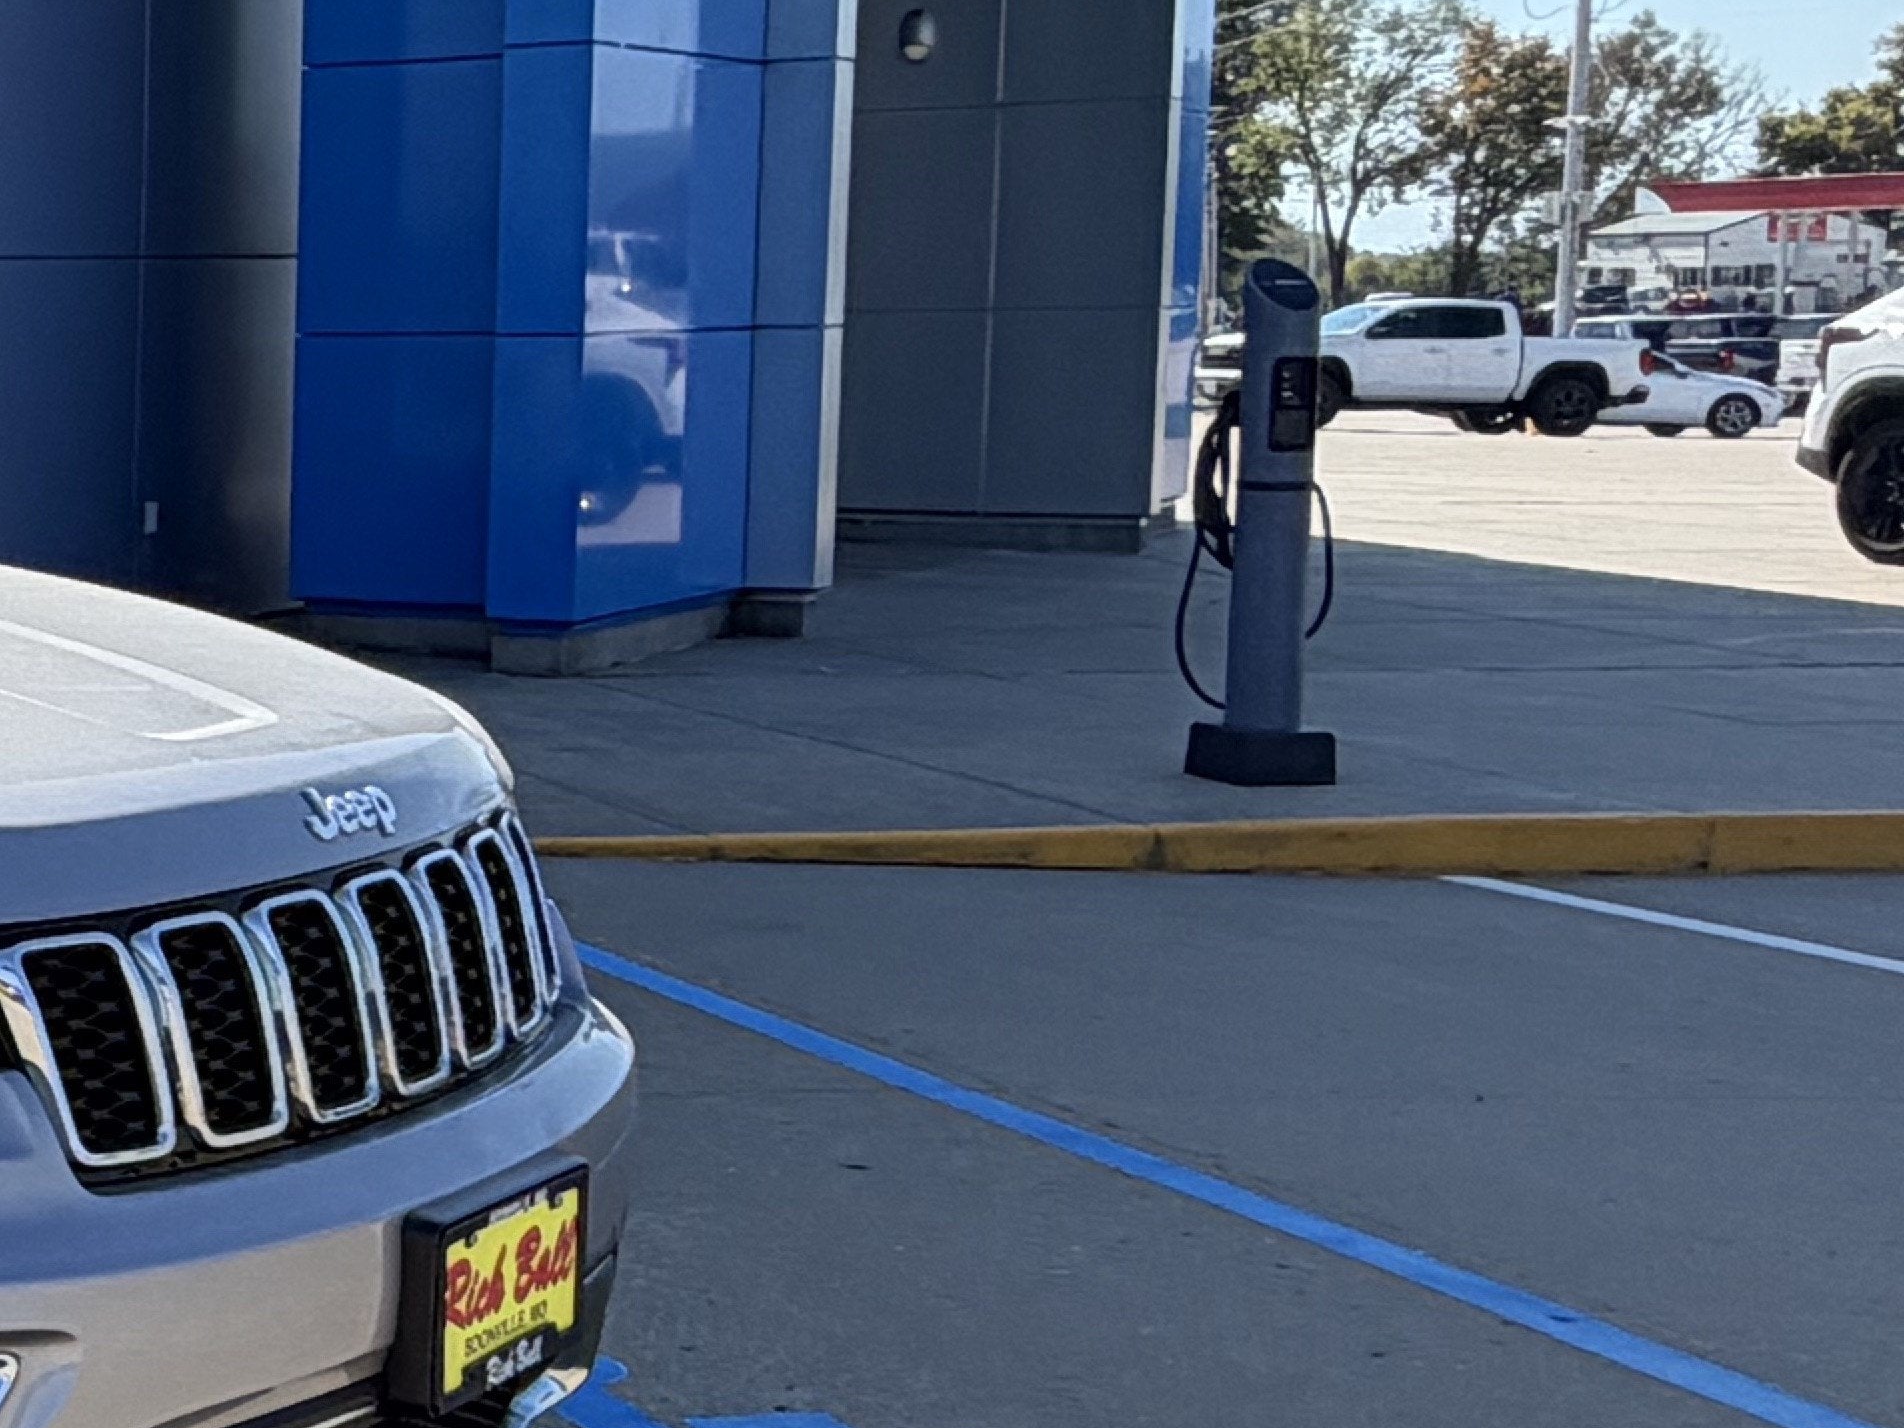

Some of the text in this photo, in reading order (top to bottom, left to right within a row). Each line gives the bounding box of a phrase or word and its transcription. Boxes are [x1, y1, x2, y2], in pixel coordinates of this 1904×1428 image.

[300, 785, 397, 841] Jeep
[444, 1216, 579, 1329] Rick Ball
